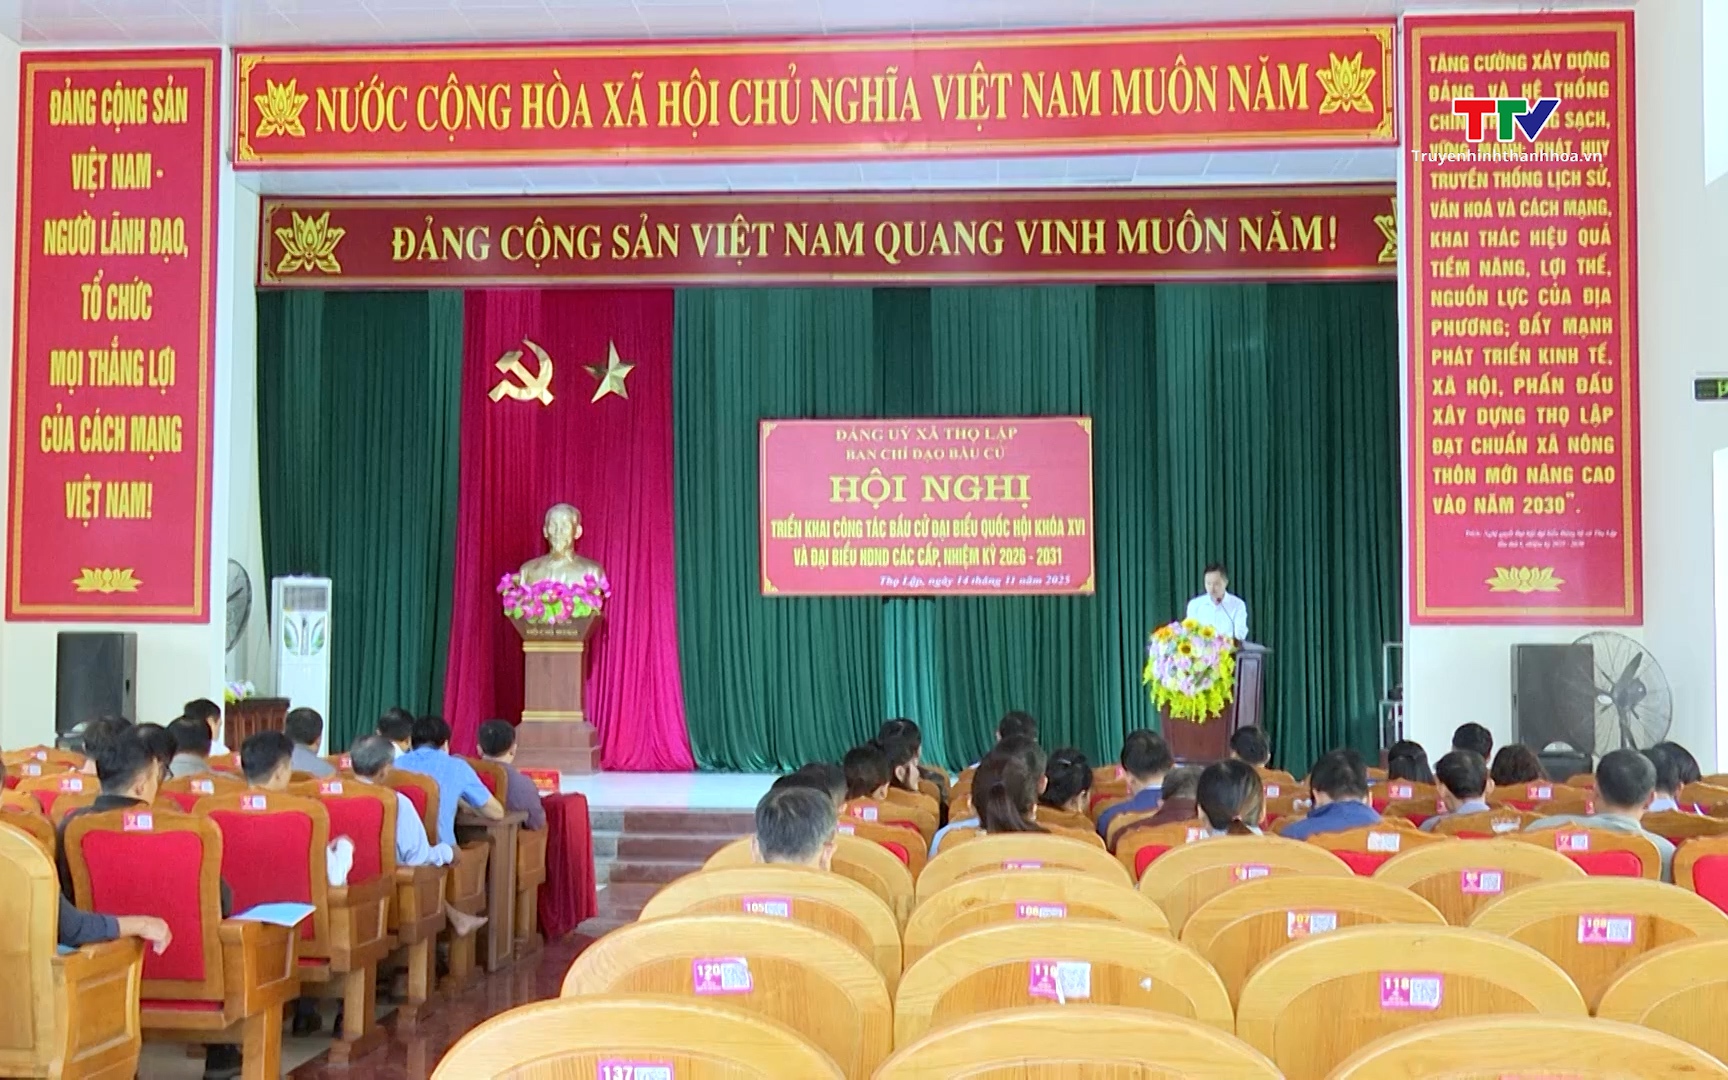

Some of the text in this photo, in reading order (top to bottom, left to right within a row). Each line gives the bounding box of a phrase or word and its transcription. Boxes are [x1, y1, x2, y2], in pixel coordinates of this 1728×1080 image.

[1428, 50, 1610, 73] TĂNG CƯỜNG XÂY DỰNG
[316, 54, 1309, 142] NƯỚC CỘNG HÒA XÃ HỘI CHỦ NGHĨA VIỆT NAM MUÔN NĂM
[1488, 79, 1509, 98] VÀ
[1554, 75, 1609, 98] THỐNG
[50, 75, 188, 133] ĐẢNG CỘNG SẢN
[1429, 112, 1466, 131] CHÍN
[71, 147, 107, 197] VIỆT
[111, 154, 151, 190] NAM
[1430, 166, 1489, 190] TRUYỀN
[1493, 165, 1542, 189] THỐNG
[1547, 169, 1581, 191] LỊCH
[1430, 197, 1459, 219] VĂN
[1464, 197, 1493, 218] HOÁ
[1497, 197, 1516, 218] VÀ
[1520, 197, 1559, 217] CÁCH
[44, 209, 189, 263] NGƯỜI LÃNH ĐẠO,
[392, 209, 1338, 269] ĐẢNG CỘNG SẢN VIỆT NAM QUANG VINH MUÔN NĂM!
[1430, 221, 1612, 250] KHAI THÁC HIỆU QUẢ
[1430, 255, 1470, 278] TIỀM
[1540, 257, 1566, 279] LỢI
[81, 269, 152, 320] TỔ CHỨC
[1431, 282, 1612, 310] NGUỒN LỰC CỦA ĐỊA
[1563, 317, 1612, 339] MẠNH
[50, 336, 175, 395] MỌI THẮNG LỢI
[1431, 345, 1474, 366] PHÁT
[1482, 341, 1531, 366] TRIỂN
[1538, 346, 1578, 365] KINH
[1432, 374, 1456, 396] XÃ
[1513, 371, 1564, 395] PHẤN
[1576, 371, 1613, 395] ĐẤU
[1432, 403, 1614, 429] XÂY DỰNG THỌ LẬP
[41, 403, 182, 461] CỦA CÁCH MẠNG
[1432, 429, 1615, 459] ĐẠT CHUẨN XÃ NÔNG
[846, 449, 877, 460] BAN
[1432, 463, 1615, 485] THÔN MỚI NÂNG CAO
[66, 475, 152, 527] VIỆT NAM!
[829, 467, 1031, 510] HỘI NGHỊ
[1432, 493, 1467, 515] VÀO
[1474, 493, 1514, 515] NĂM
[771, 513, 802, 539] TRIỂN
[804, 519, 831, 538] KHAI
[833, 516, 863, 538] CÔNG
[866, 516, 887, 538] TÁC
[914, 513, 930, 538] CỬ
[953, 512, 978, 537] BIỂU
[981, 512, 1010, 539] QUỐC
[1013, 514, 1031, 541] HỘI
[1067, 518, 1085, 536] XVI
[793, 544, 808, 566] VÀ
[831, 540, 857, 566] BIỂU
[892, 544, 914, 566] CÁC
[944, 543, 979, 570] NHIỆM
[982, 543, 996, 565] KỲ
[999, 547, 1026, 566] 2026
[1036, 547, 1062, 566] 2031
[697, 963, 721, 977] 120
[603, 1064, 634, 1080] 137
